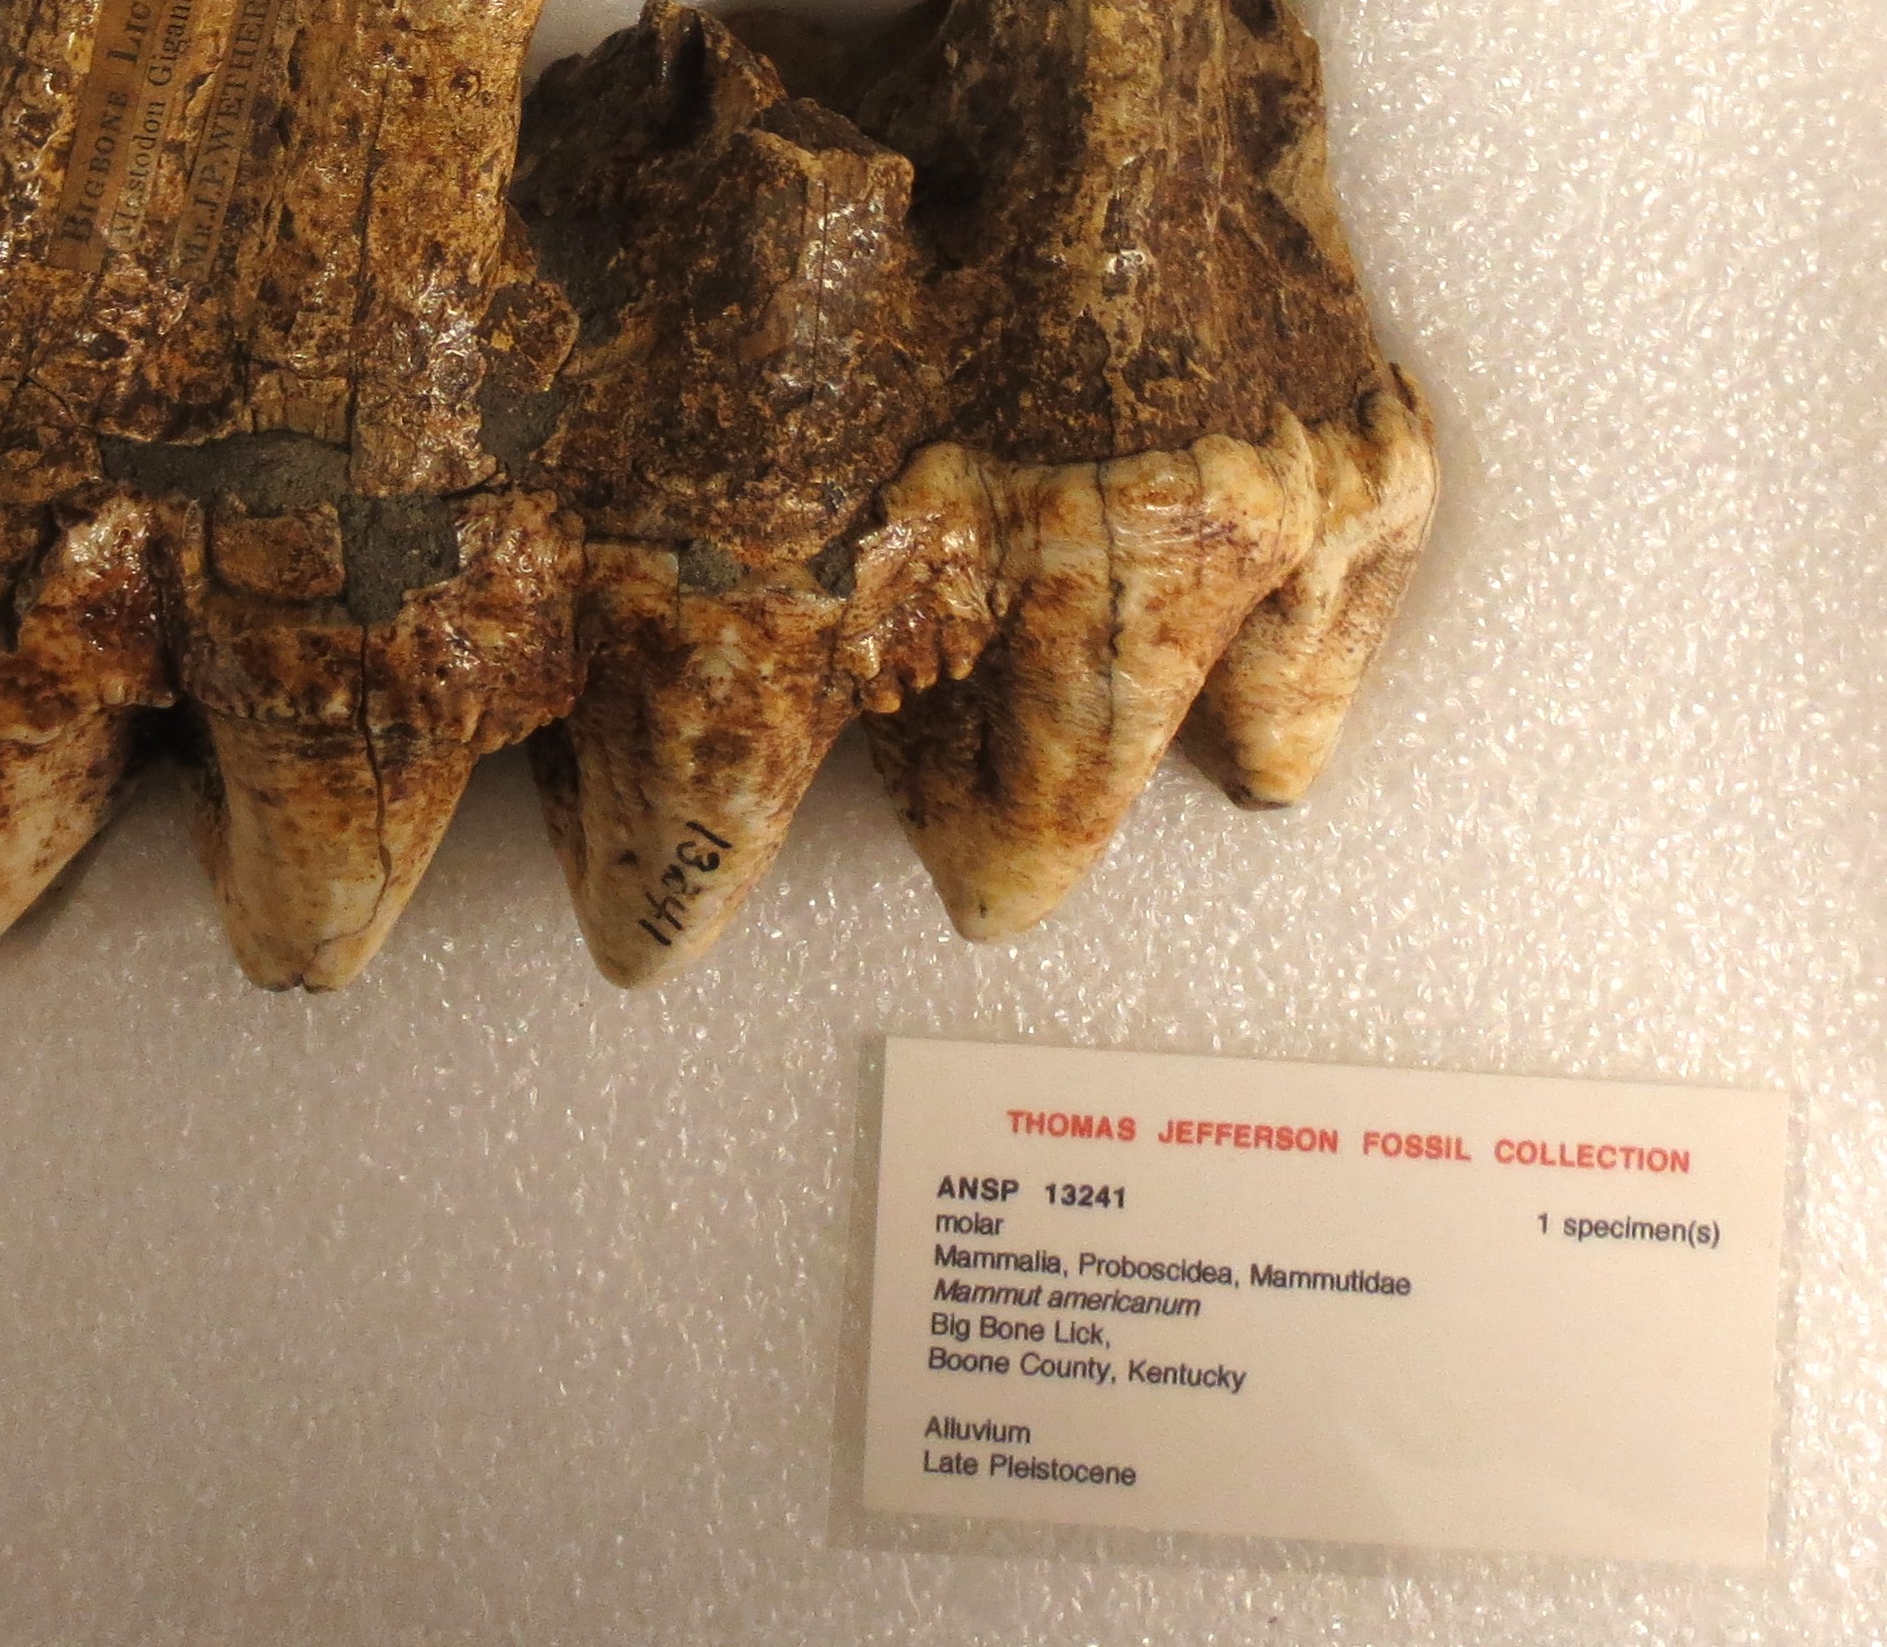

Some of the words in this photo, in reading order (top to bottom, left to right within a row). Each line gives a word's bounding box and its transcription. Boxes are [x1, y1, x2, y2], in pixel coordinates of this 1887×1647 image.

[638, 821, 732, 946] 13241
[1007, 1109, 1137, 1142] THOMAS
[1158, 1119, 1340, 1154] JEFFERSON
[1362, 1131, 1472, 1161] FOSSIL
[1494, 1138, 1691, 1174] COLLECTION
[937, 1175, 1020, 1203] ANSP
[1045, 1182, 1127, 1209] 13241
[935, 1211, 1004, 1236] molar
[1536, 1212, 1549, 1235] 1
[1562, 1215, 1721, 1249] specimen(s)
[934, 1244, 1069, 1278] Mammalia,
[1078, 1251, 1240, 1289] Proboscidea,
[1250, 1263, 1412, 1297] Mammutidae
[933, 1278, 1043, 1308] Mammut
[1047, 1287, 1201, 1317] americanum
[930, 1312, 971, 1342] Big
[979, 1315, 1045, 1343] Bone
[1053, 1319, 1112, 1350] Lick,
[928, 1347, 1010, 1375] Boone
[1019, 1352, 1117, 1385] County,
[1127, 1360, 1247, 1394] Kentucky
[923, 1415, 1031, 1444] Alluvium
[922, 1450, 979, 1477] Late
[989, 1454, 1137, 1487] Pleistocene
